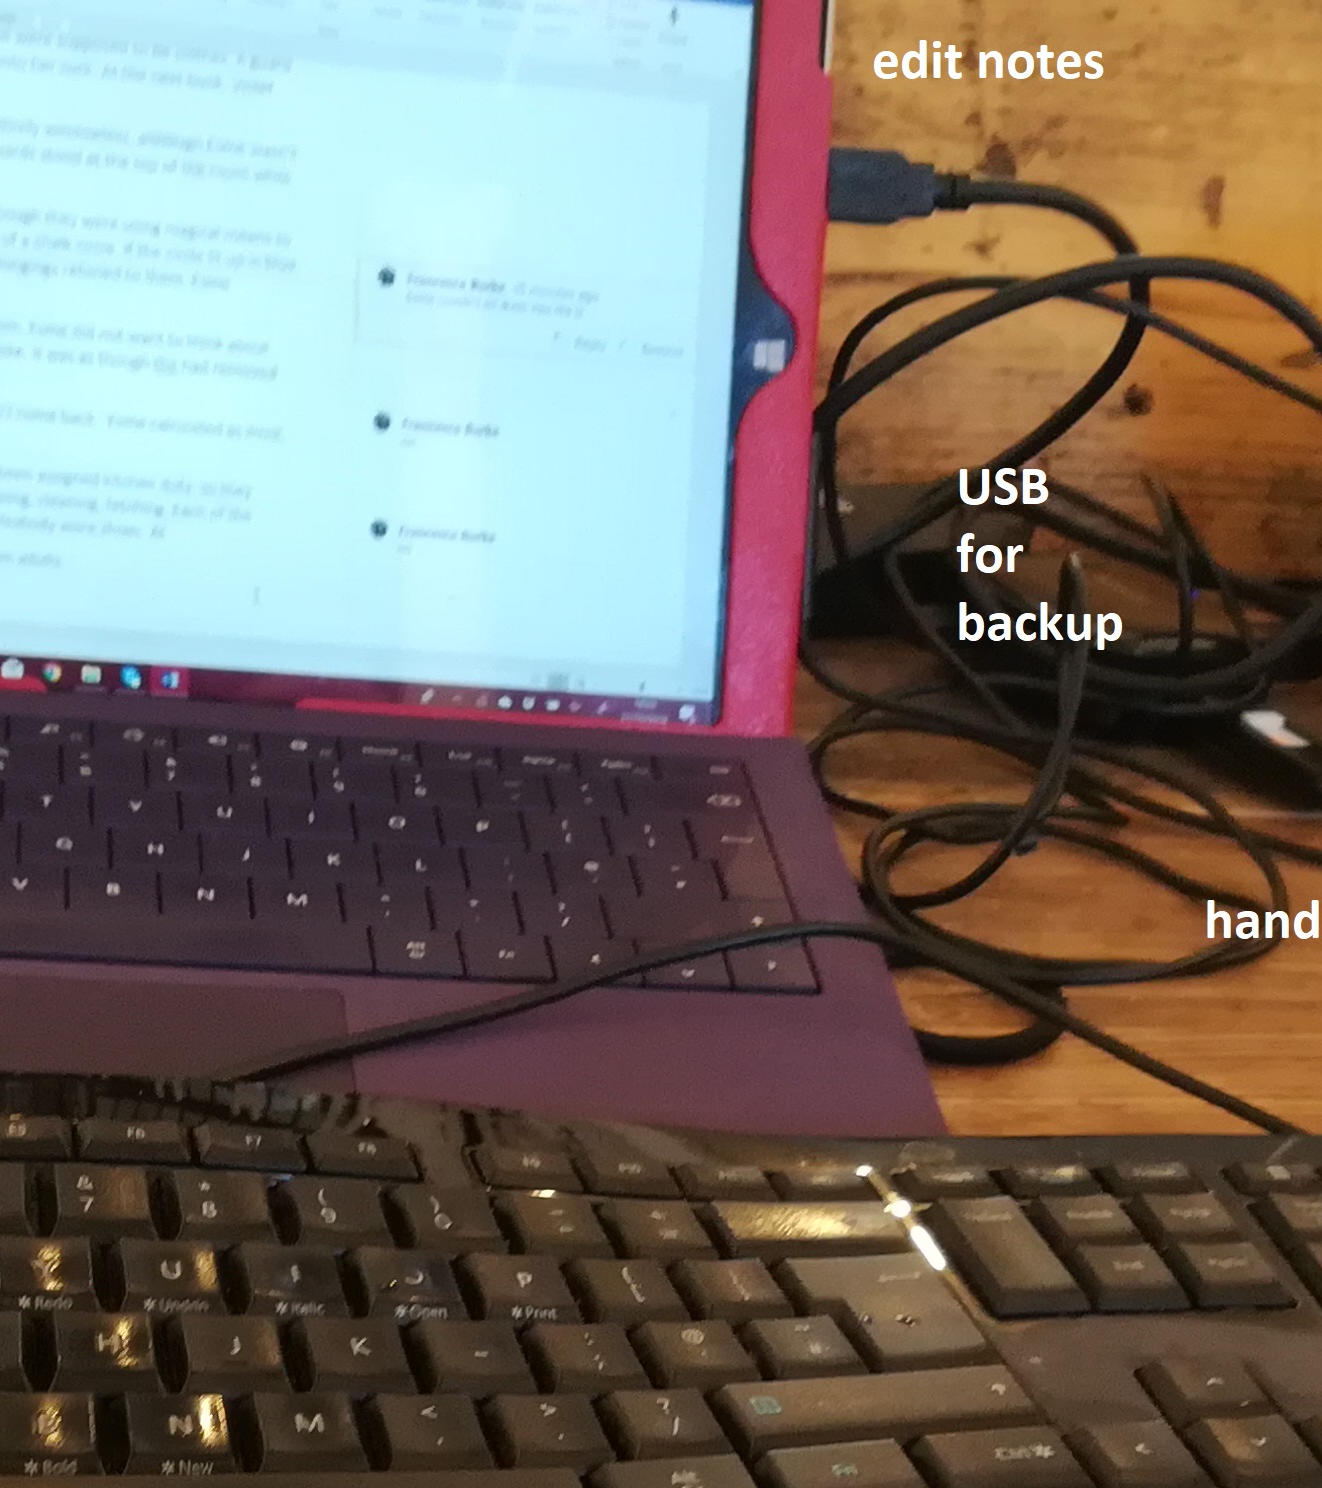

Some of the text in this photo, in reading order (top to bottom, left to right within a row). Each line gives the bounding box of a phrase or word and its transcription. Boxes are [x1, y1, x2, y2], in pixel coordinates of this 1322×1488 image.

[286, 892, 310, 908] M
[161, 1260, 182, 1280] U
[350, 1336, 372, 1357] K
[168, 1413, 194, 1436] N
[294, 1412, 326, 1434] M
[177, 1459, 215, 1476] New
